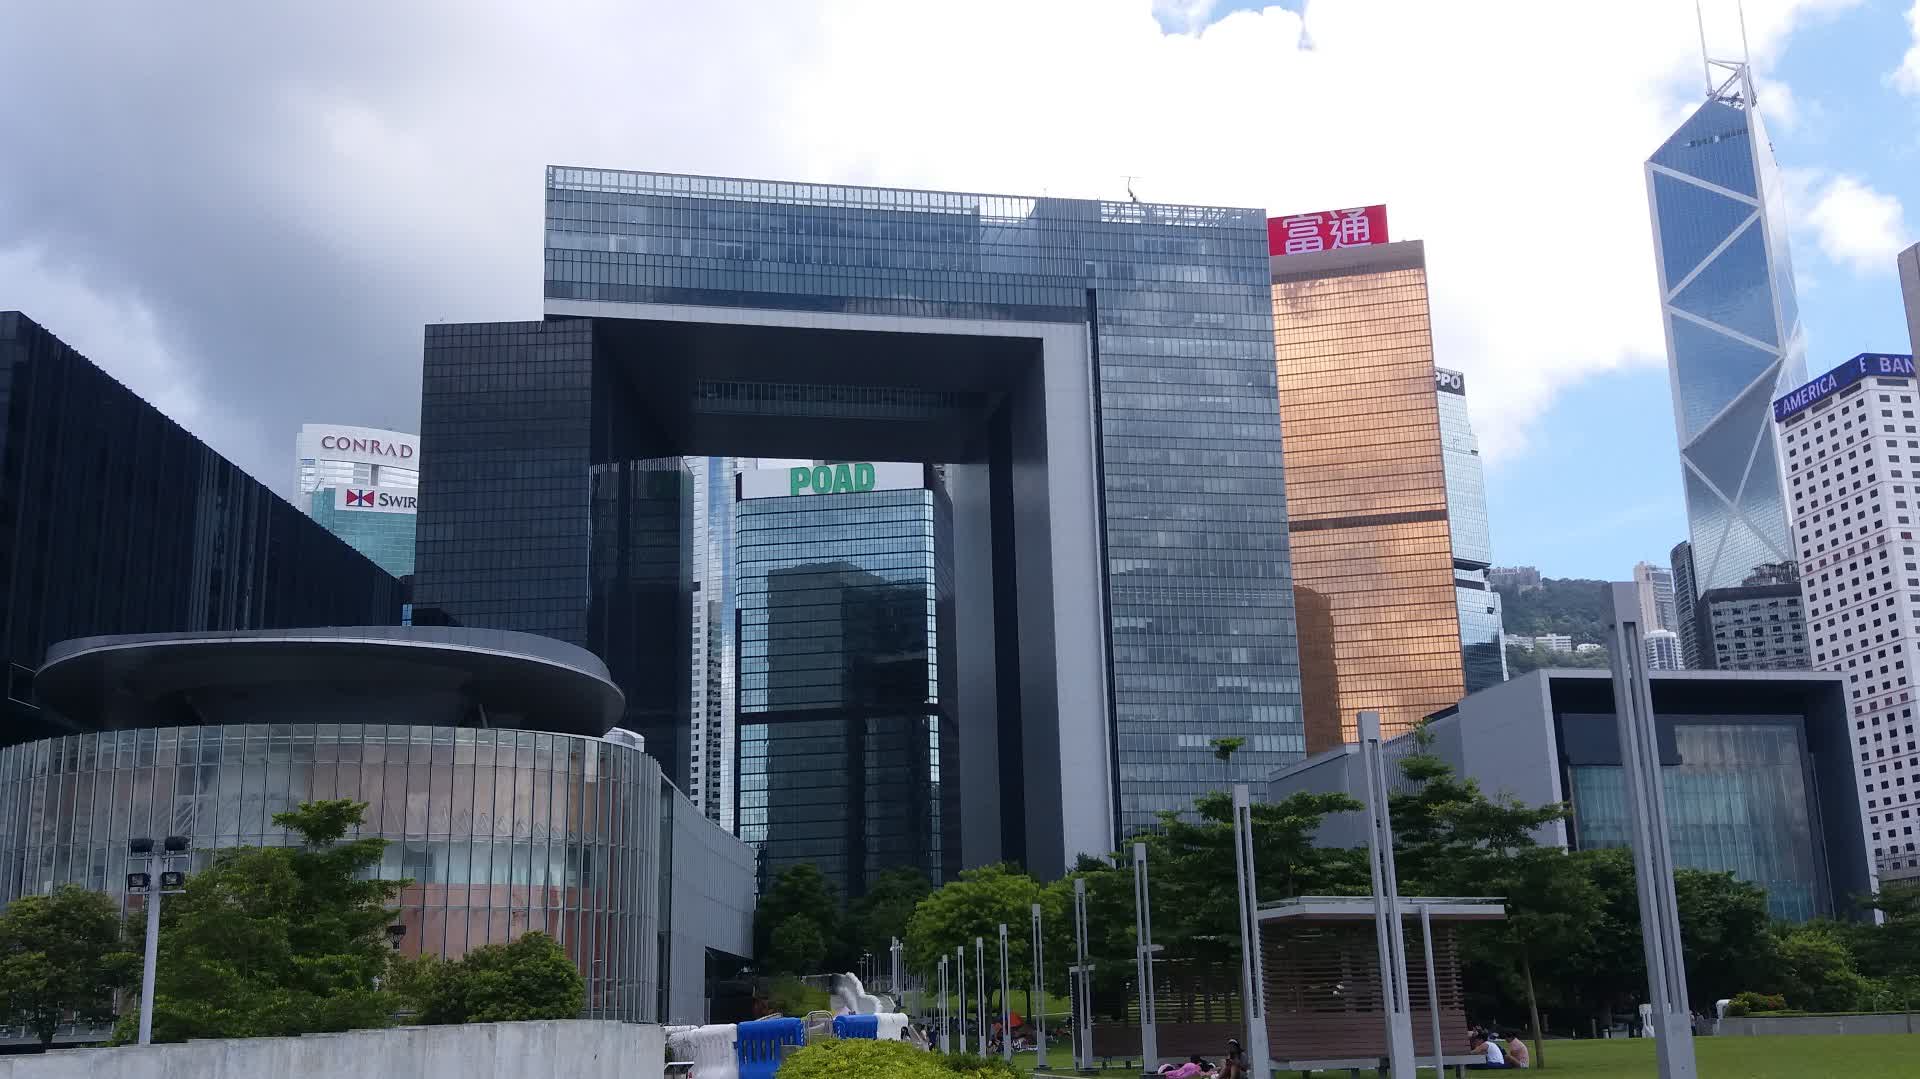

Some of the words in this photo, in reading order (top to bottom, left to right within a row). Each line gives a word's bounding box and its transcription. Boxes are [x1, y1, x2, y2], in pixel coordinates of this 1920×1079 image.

[1283, 208, 1372, 256] 富通
[1783, 374, 1837, 414] AMERICA
[321, 436, 413, 458] CONRAD
[790, 463, 875, 496] POAD
